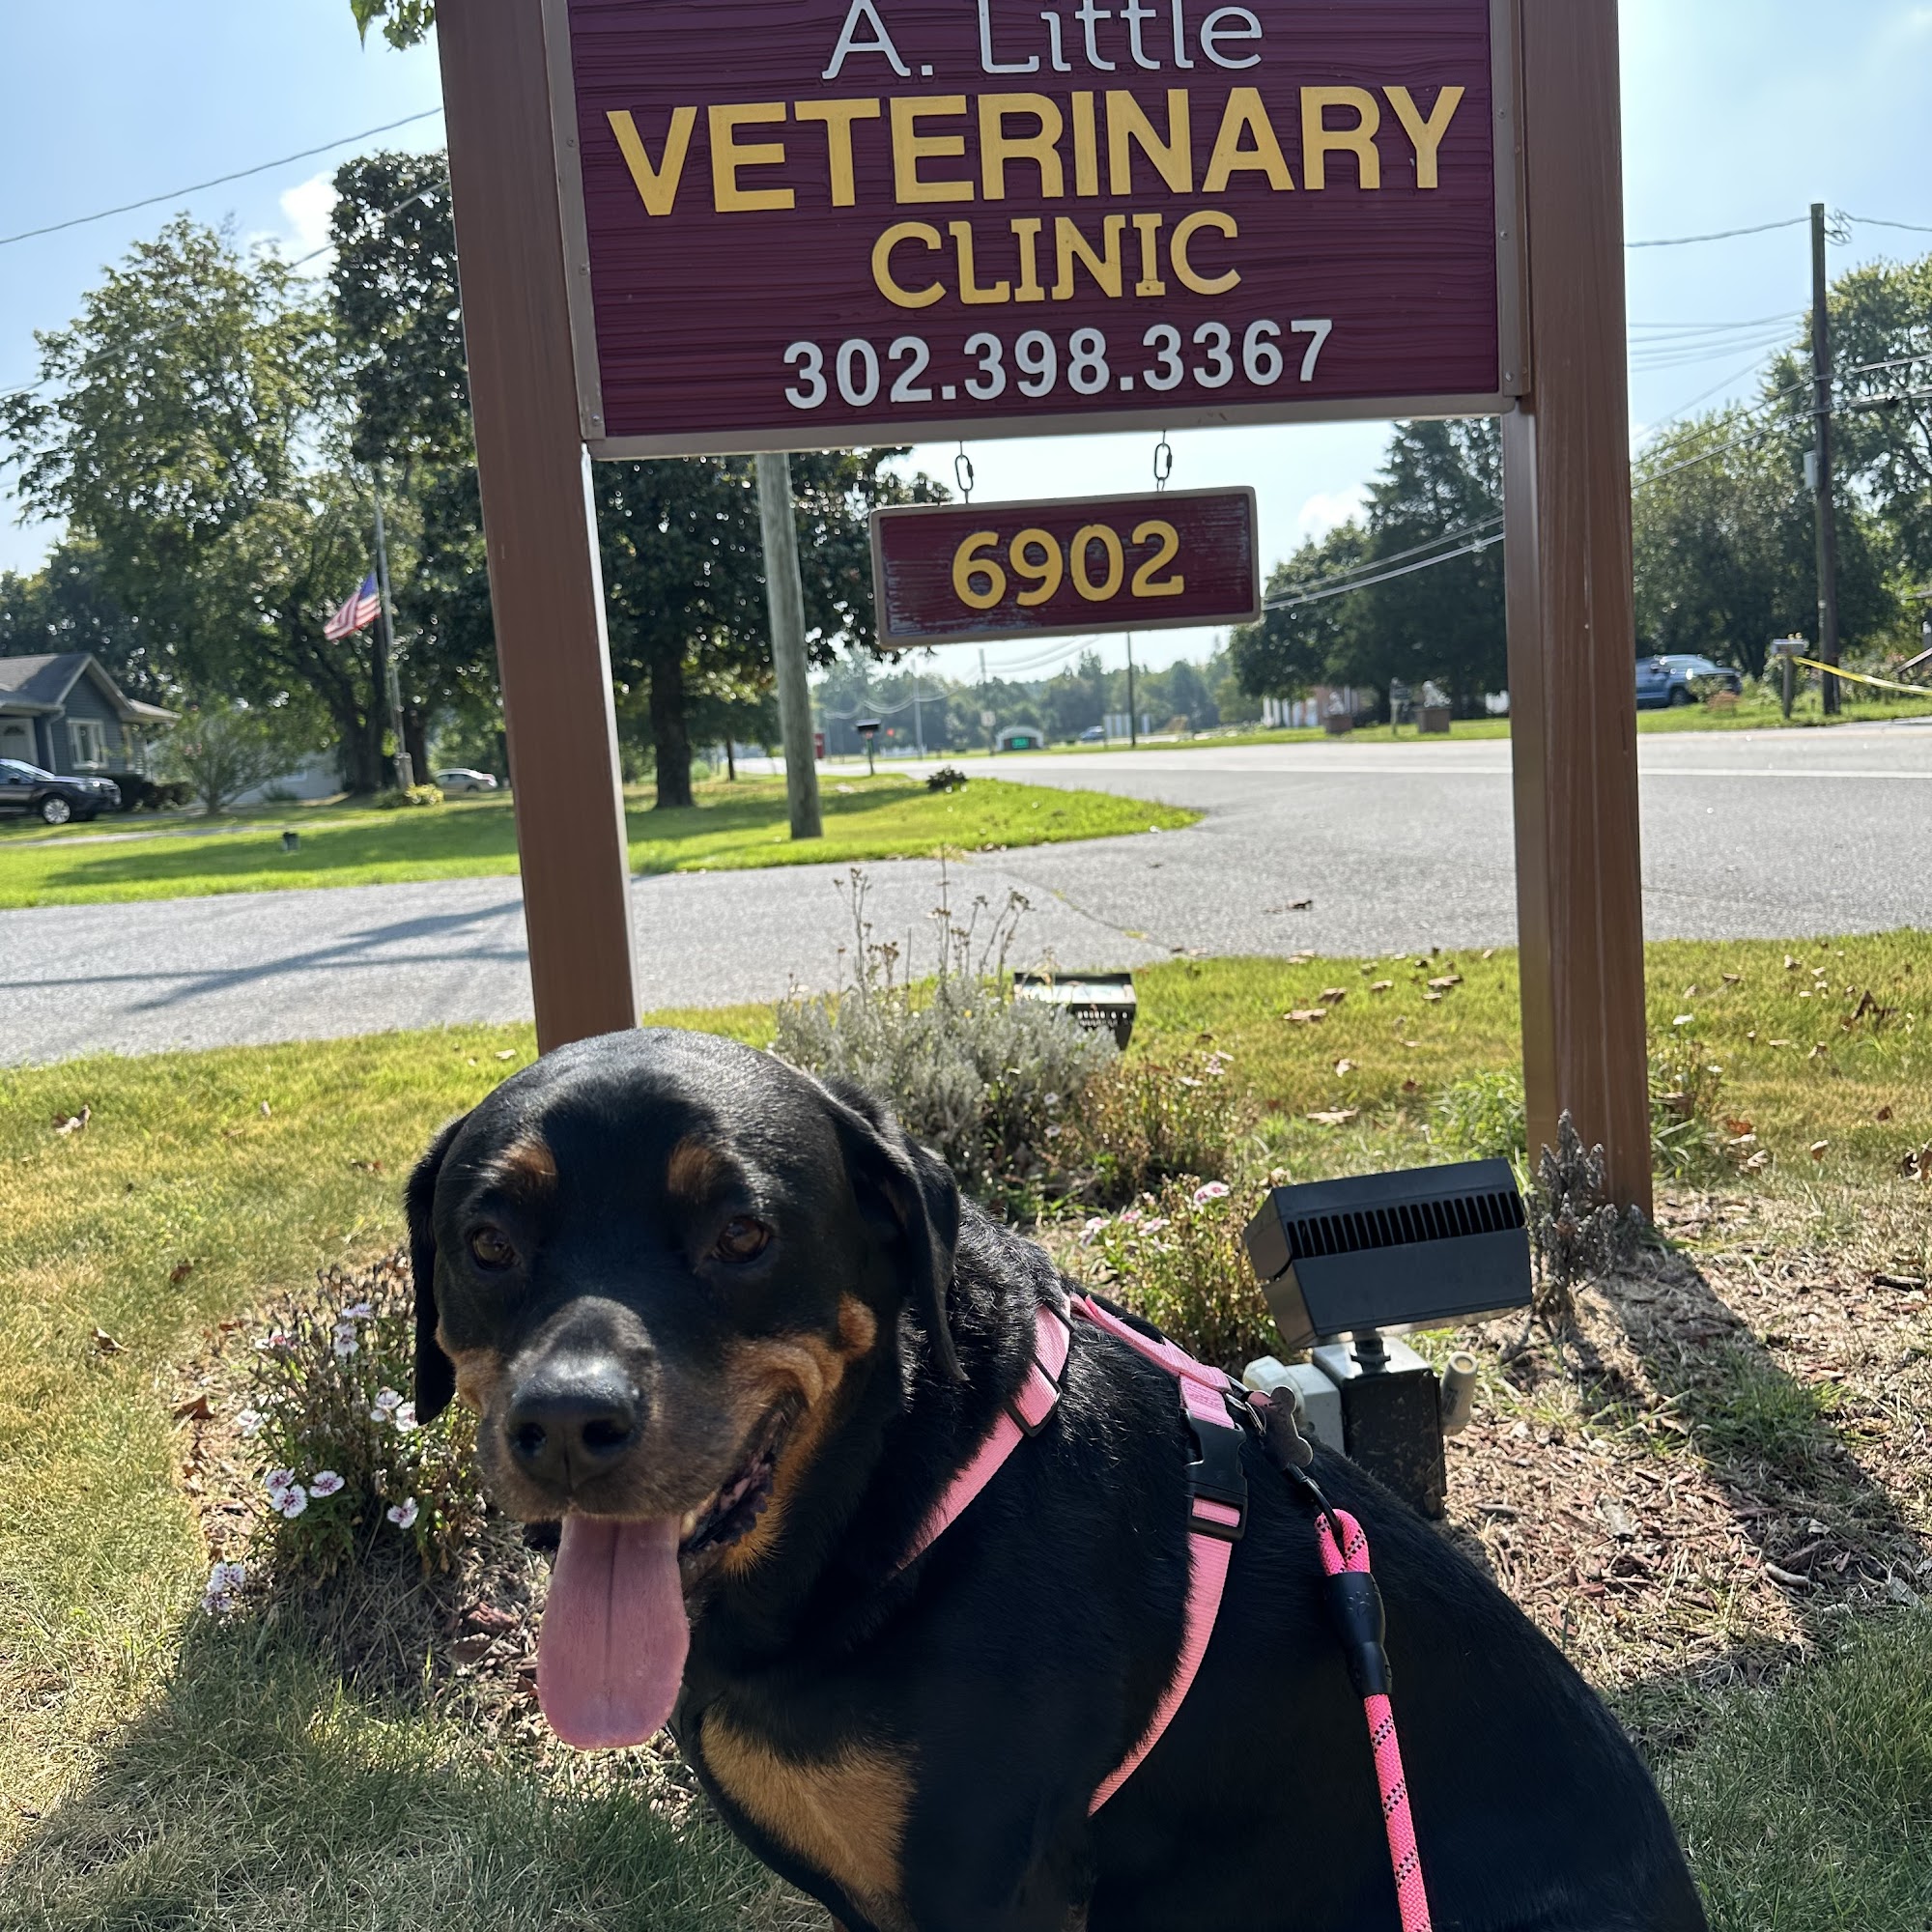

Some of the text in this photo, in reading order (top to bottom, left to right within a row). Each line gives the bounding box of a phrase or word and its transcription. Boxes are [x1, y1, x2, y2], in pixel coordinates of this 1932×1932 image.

[821, 0, 1263, 79] A. Little
[606, 85, 1464, 216] VETERINARY
[870, 210, 1241, 309] CLINIC
[782, 318, 1334, 411] 302.398.3367
[952, 520, 1185, 610] 6902
